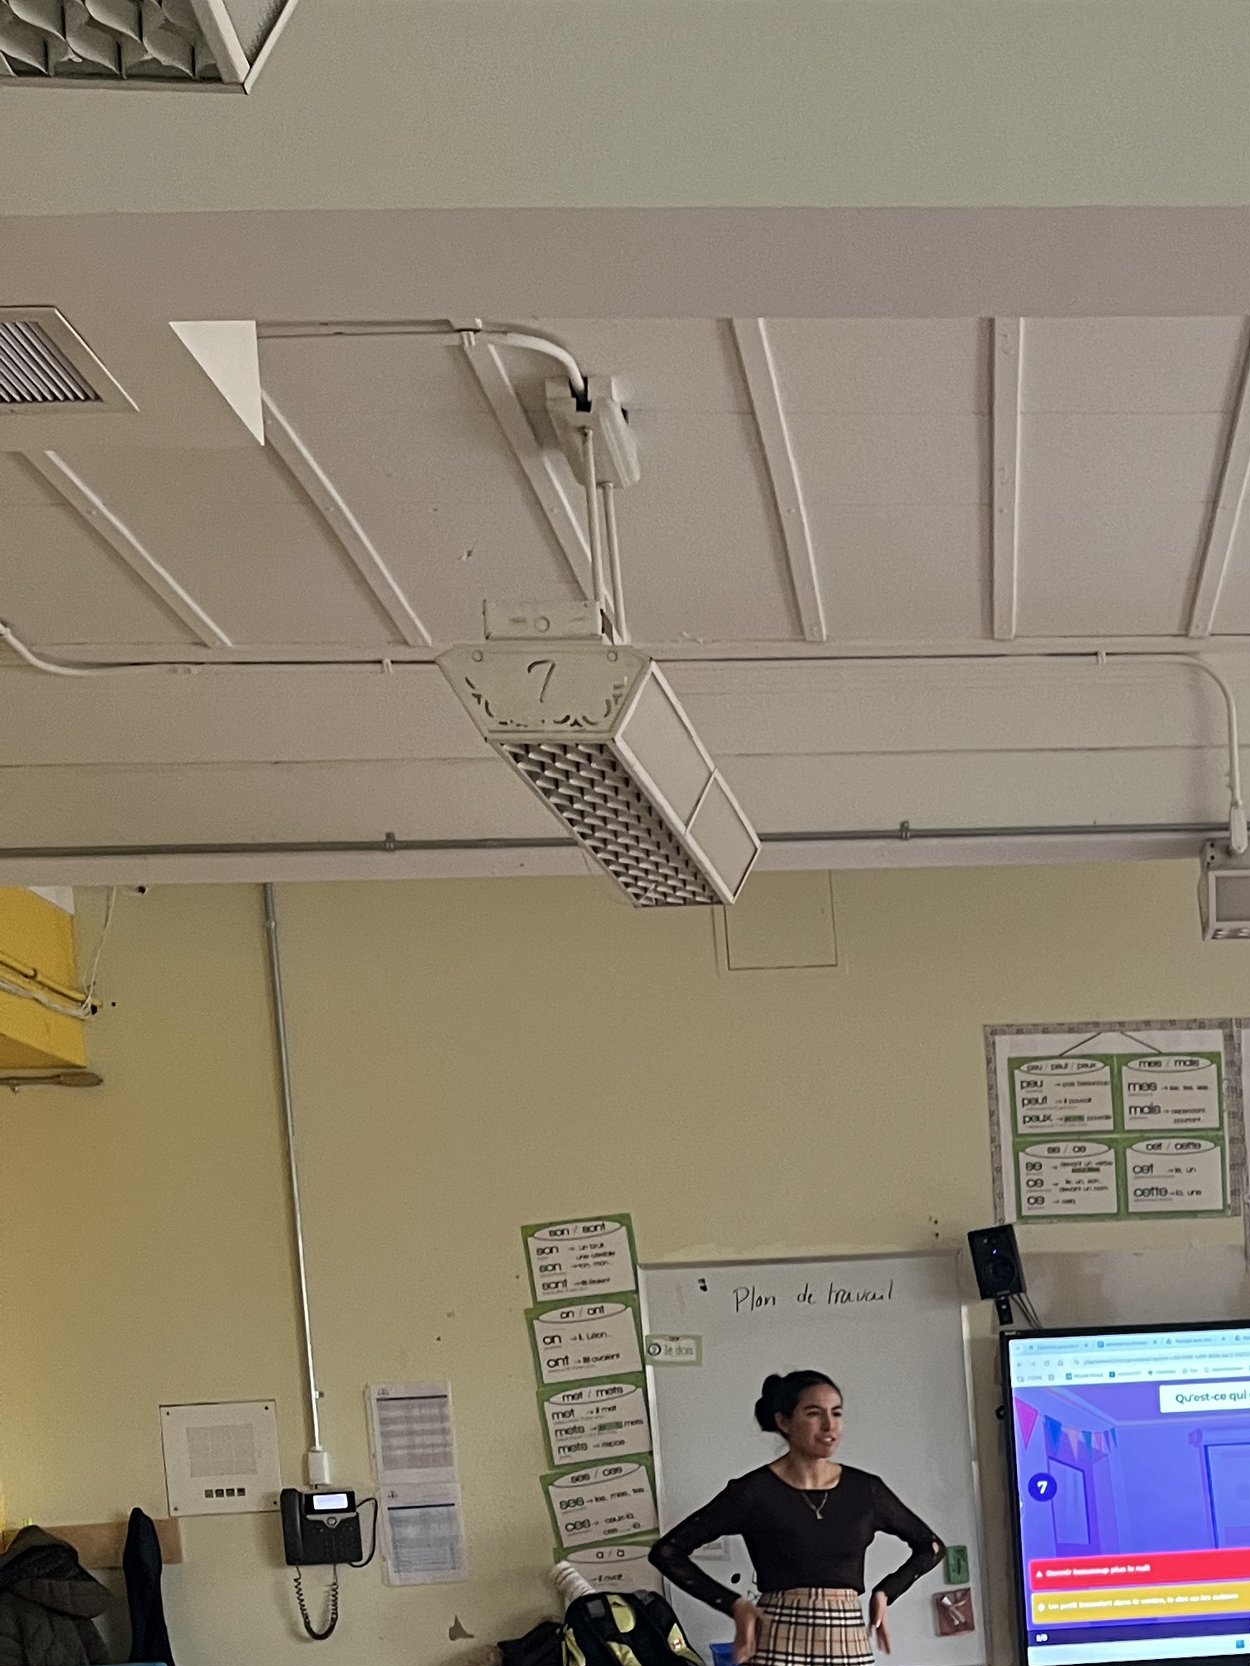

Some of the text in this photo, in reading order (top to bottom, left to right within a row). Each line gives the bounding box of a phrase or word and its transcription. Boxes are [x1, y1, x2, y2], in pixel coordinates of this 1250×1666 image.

[527, 659, 556, 703] 7
[1020, 1080, 1043, 1090] peu
[1128, 1082, 1157, 1091] mes
[1022, 1096, 1047, 1108] peut
[1128, 1103, 1161, 1115] mais
[1023, 1115, 1052, 1125] peux
[1132, 1163, 1154, 1174] cet
[1026, 1178, 1044, 1188] ce
[1133, 1186, 1168, 1198] cette
[1027, 1196, 1045, 1205] ce
[549, 1222, 606, 1237] son sont
[536, 1246, 559, 1256] son
[539, 1263, 562, 1273] son
[542, 1279, 568, 1290] sont
[733, 1279, 894, 1312] Plan de travail
[560, 1305, 605, 1319] on ont
[542, 1334, 562, 1346] on
[546, 1355, 569, 1369] ont
[562, 1386, 624, 1402] met mets
[1175, 1392, 1227, 1404] Qu'est-ce
[1229, 1390, 1247, 1403] qui
[551, 1408, 575, 1420] met
[554, 1425, 585, 1438] mets
[558, 1442, 588, 1455] mets
[1036, 1480, 1048, 1495] 7
[559, 1497, 585, 1510] ses
[565, 1519, 591, 1532] ces
[596, 1549, 625, 1559] a à
